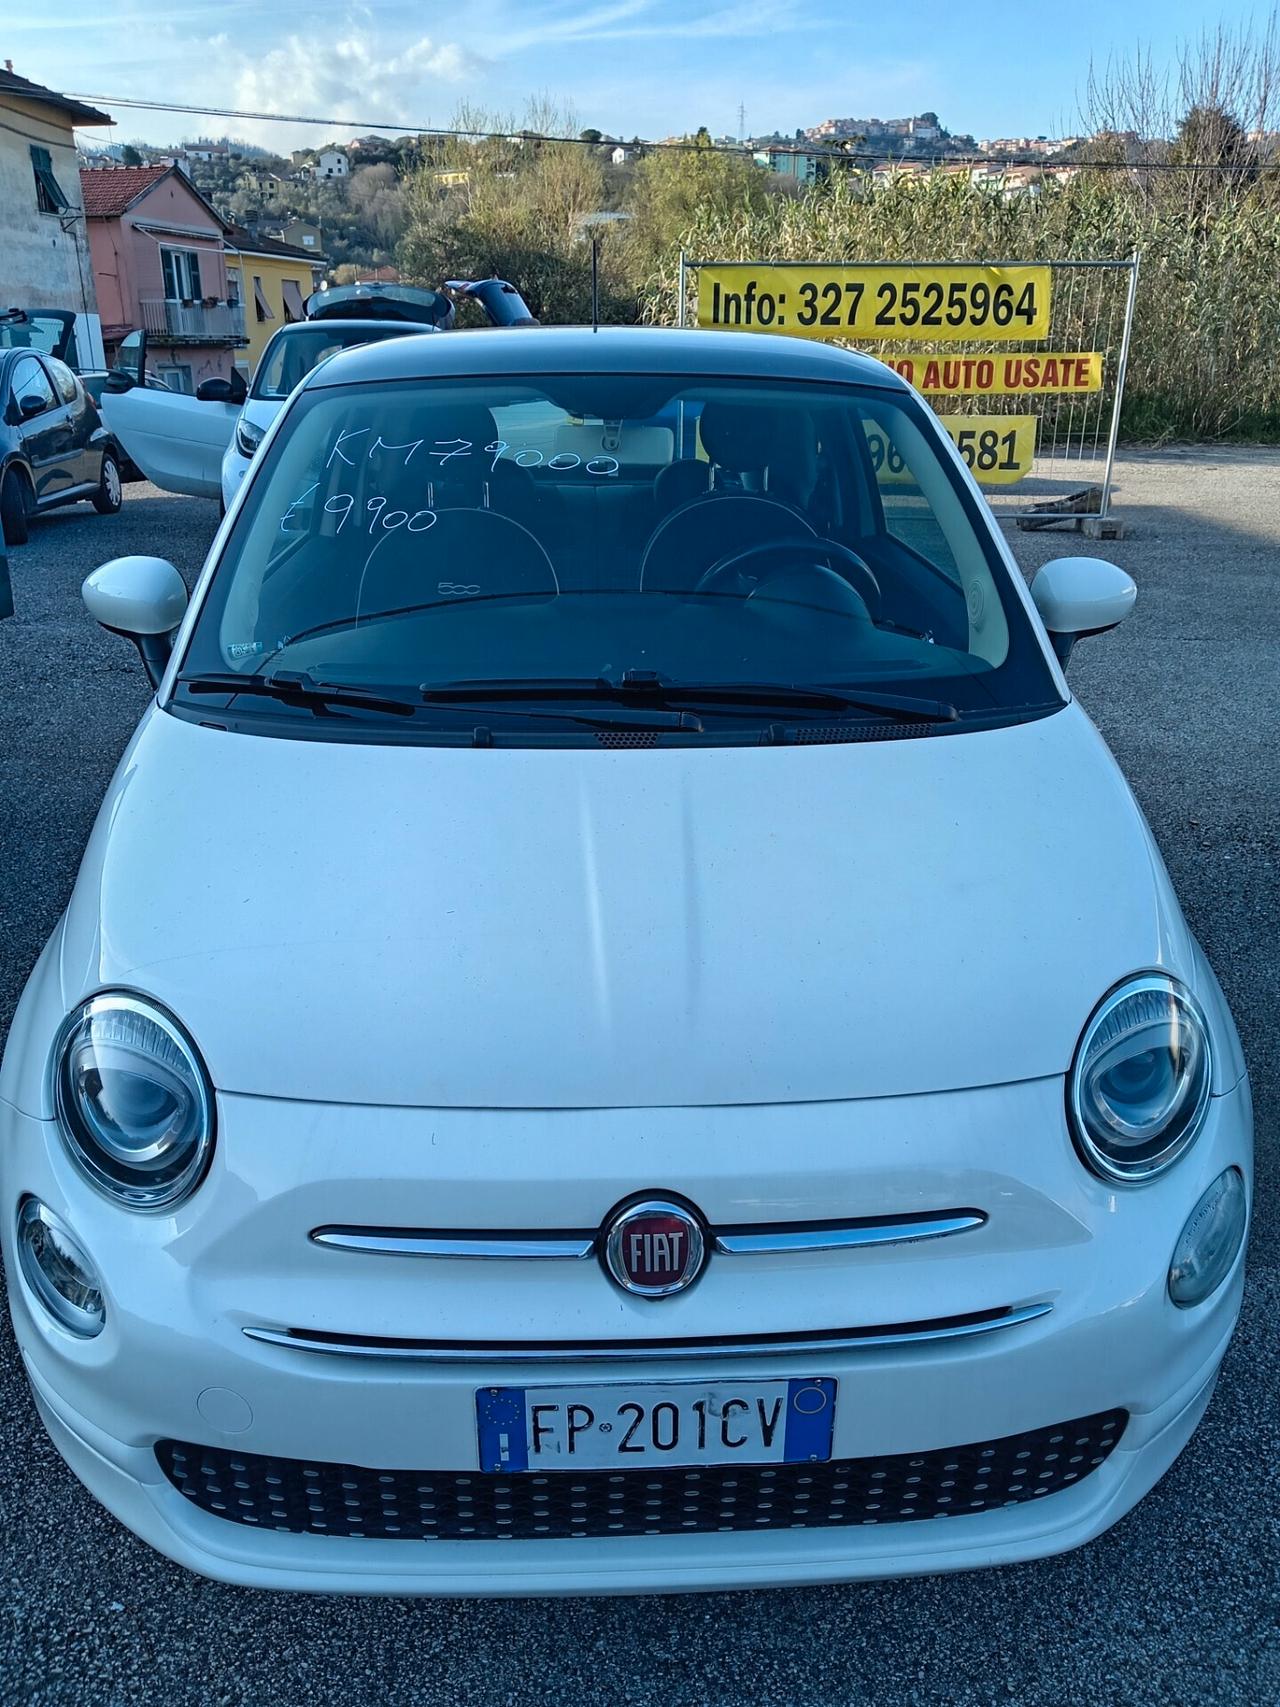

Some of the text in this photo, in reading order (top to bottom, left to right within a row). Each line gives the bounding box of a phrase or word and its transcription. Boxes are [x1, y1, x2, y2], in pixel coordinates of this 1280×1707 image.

[712, 281, 1037, 326] Info: 327 2525964
[922, 360, 994, 389] AUTO
[1004, 358, 1090, 387] USATE
[630, 1232, 683, 1273] FIAT
